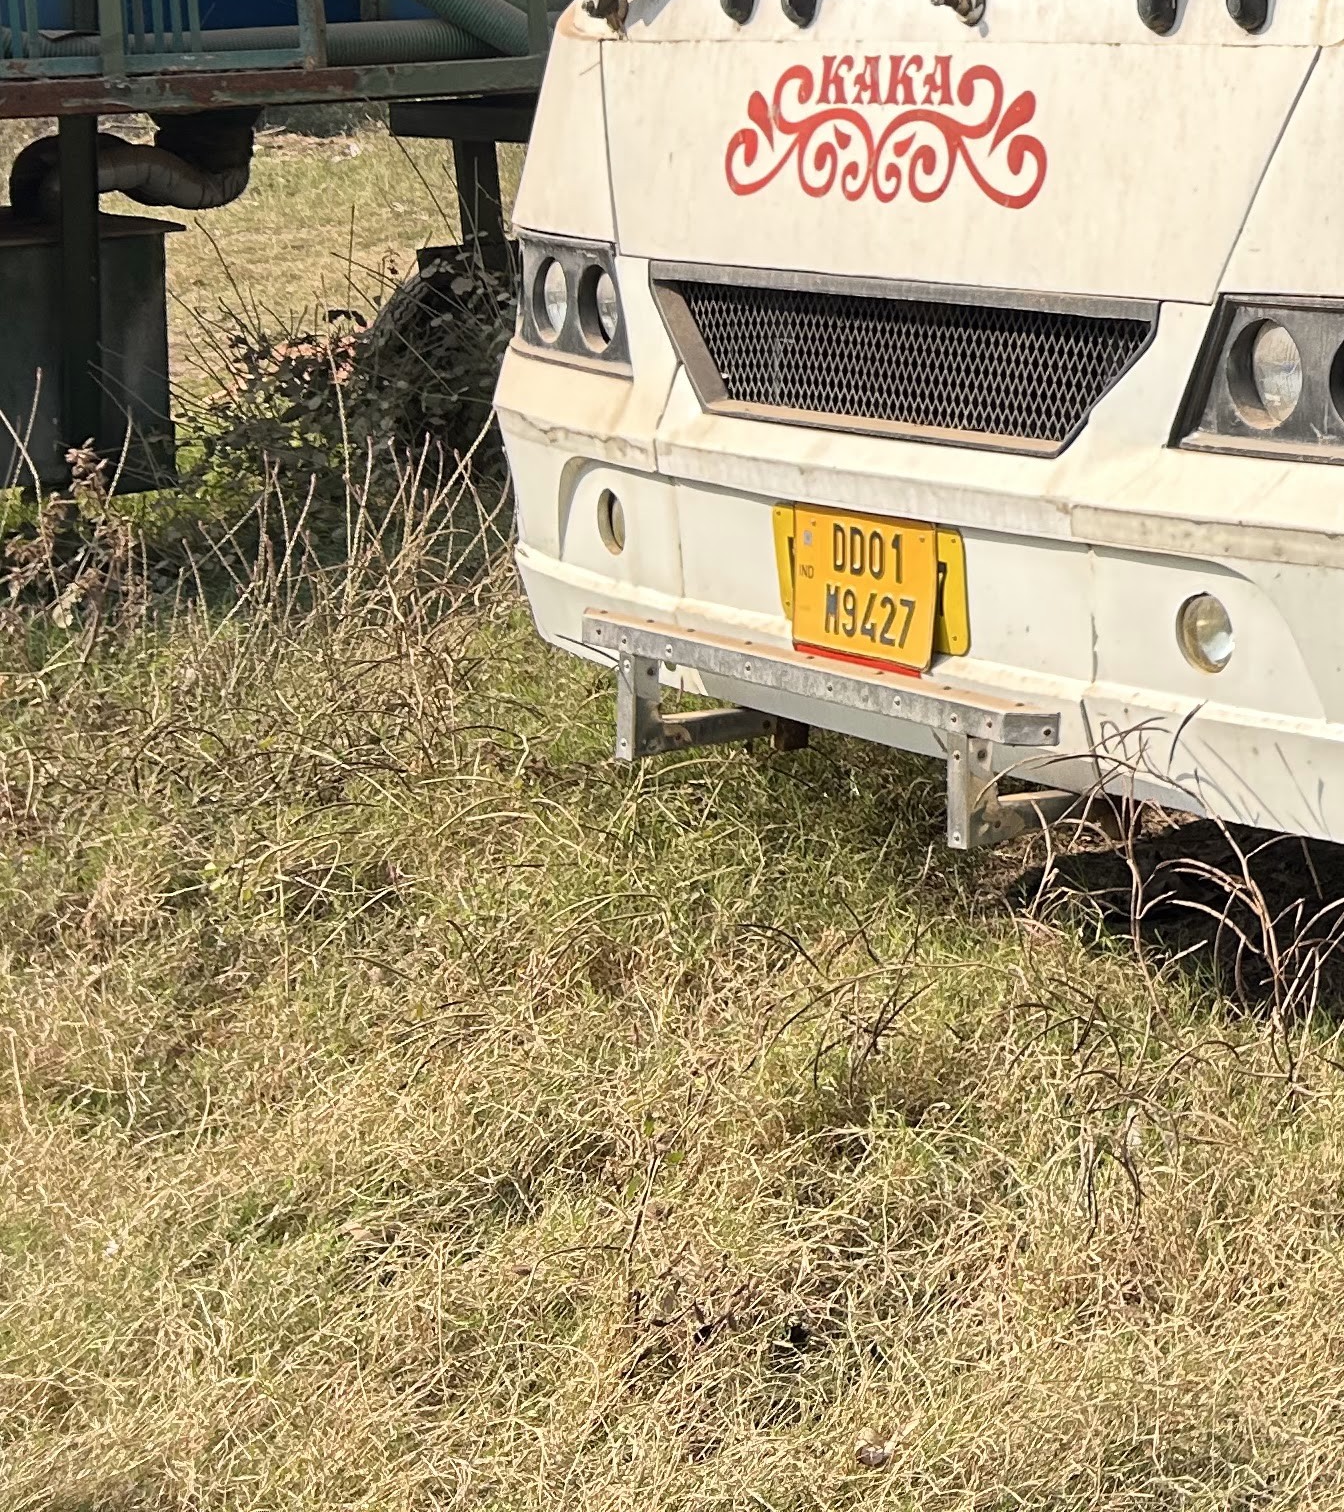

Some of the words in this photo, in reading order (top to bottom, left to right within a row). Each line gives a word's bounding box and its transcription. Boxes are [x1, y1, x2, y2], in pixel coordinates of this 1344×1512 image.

[816, 54, 953, 106] KAKA
[832, 522, 903, 585] DD01
[824, 583, 917, 650] M9427
